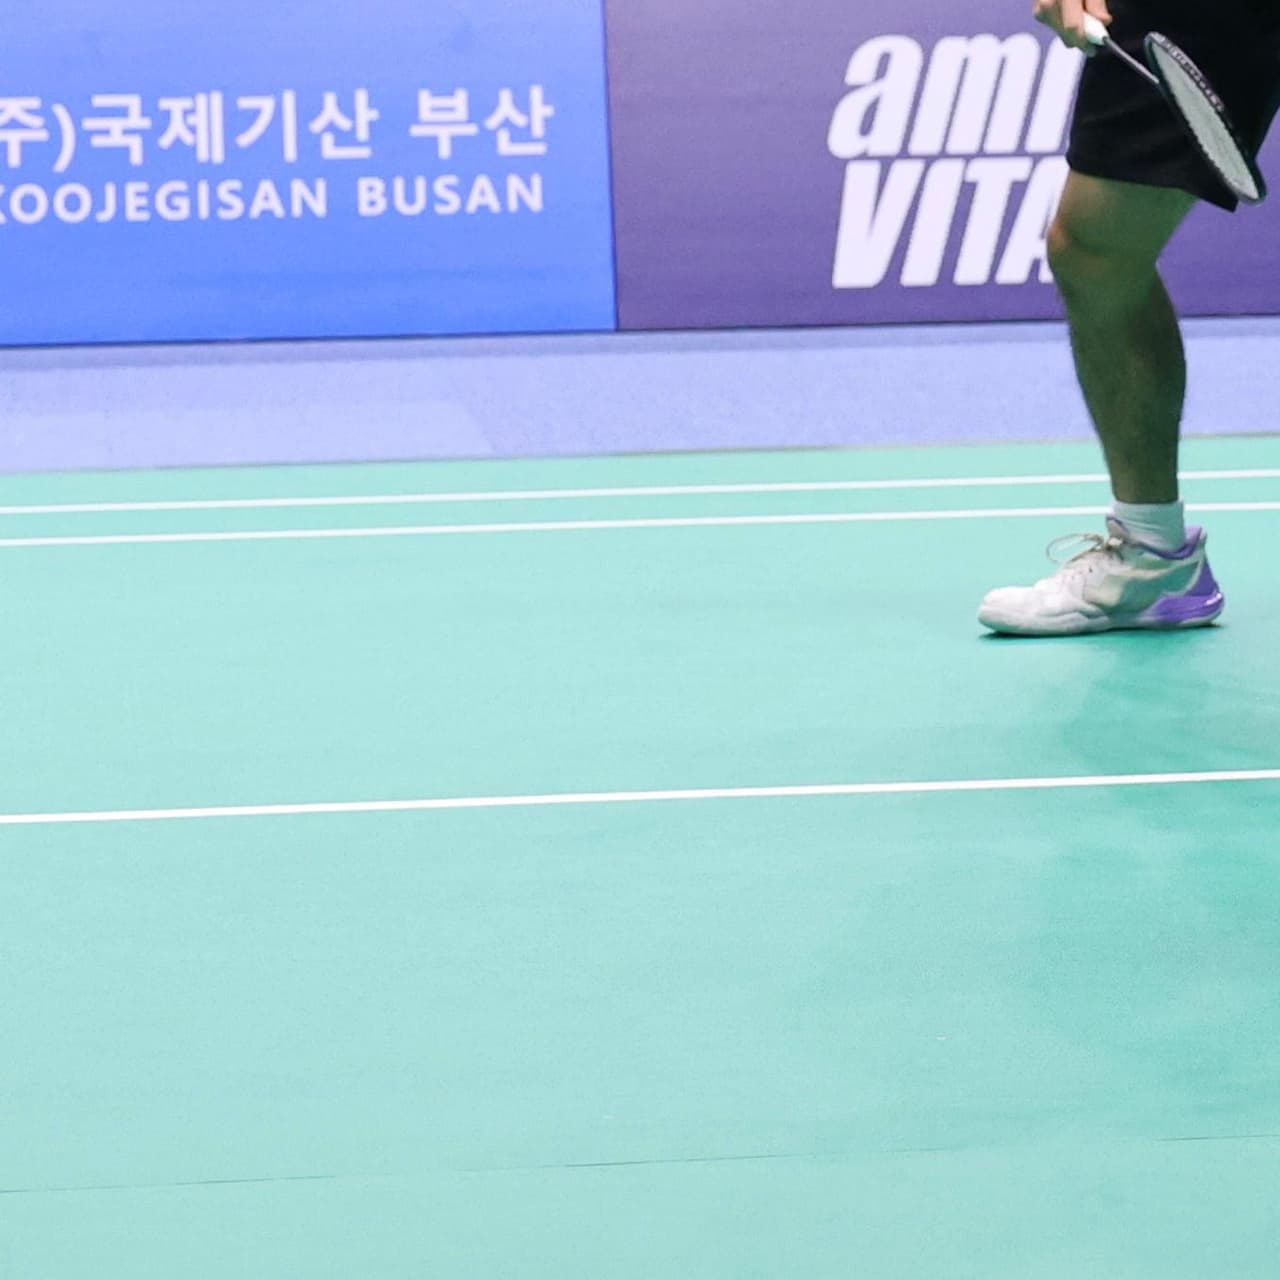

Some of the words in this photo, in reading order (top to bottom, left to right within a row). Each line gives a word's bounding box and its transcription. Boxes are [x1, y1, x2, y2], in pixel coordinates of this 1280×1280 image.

[410, 86, 555, 160] 부산
[0, 179, 328, 223] OOJEGISAN
[356, 173, 543, 216] BUSAN
